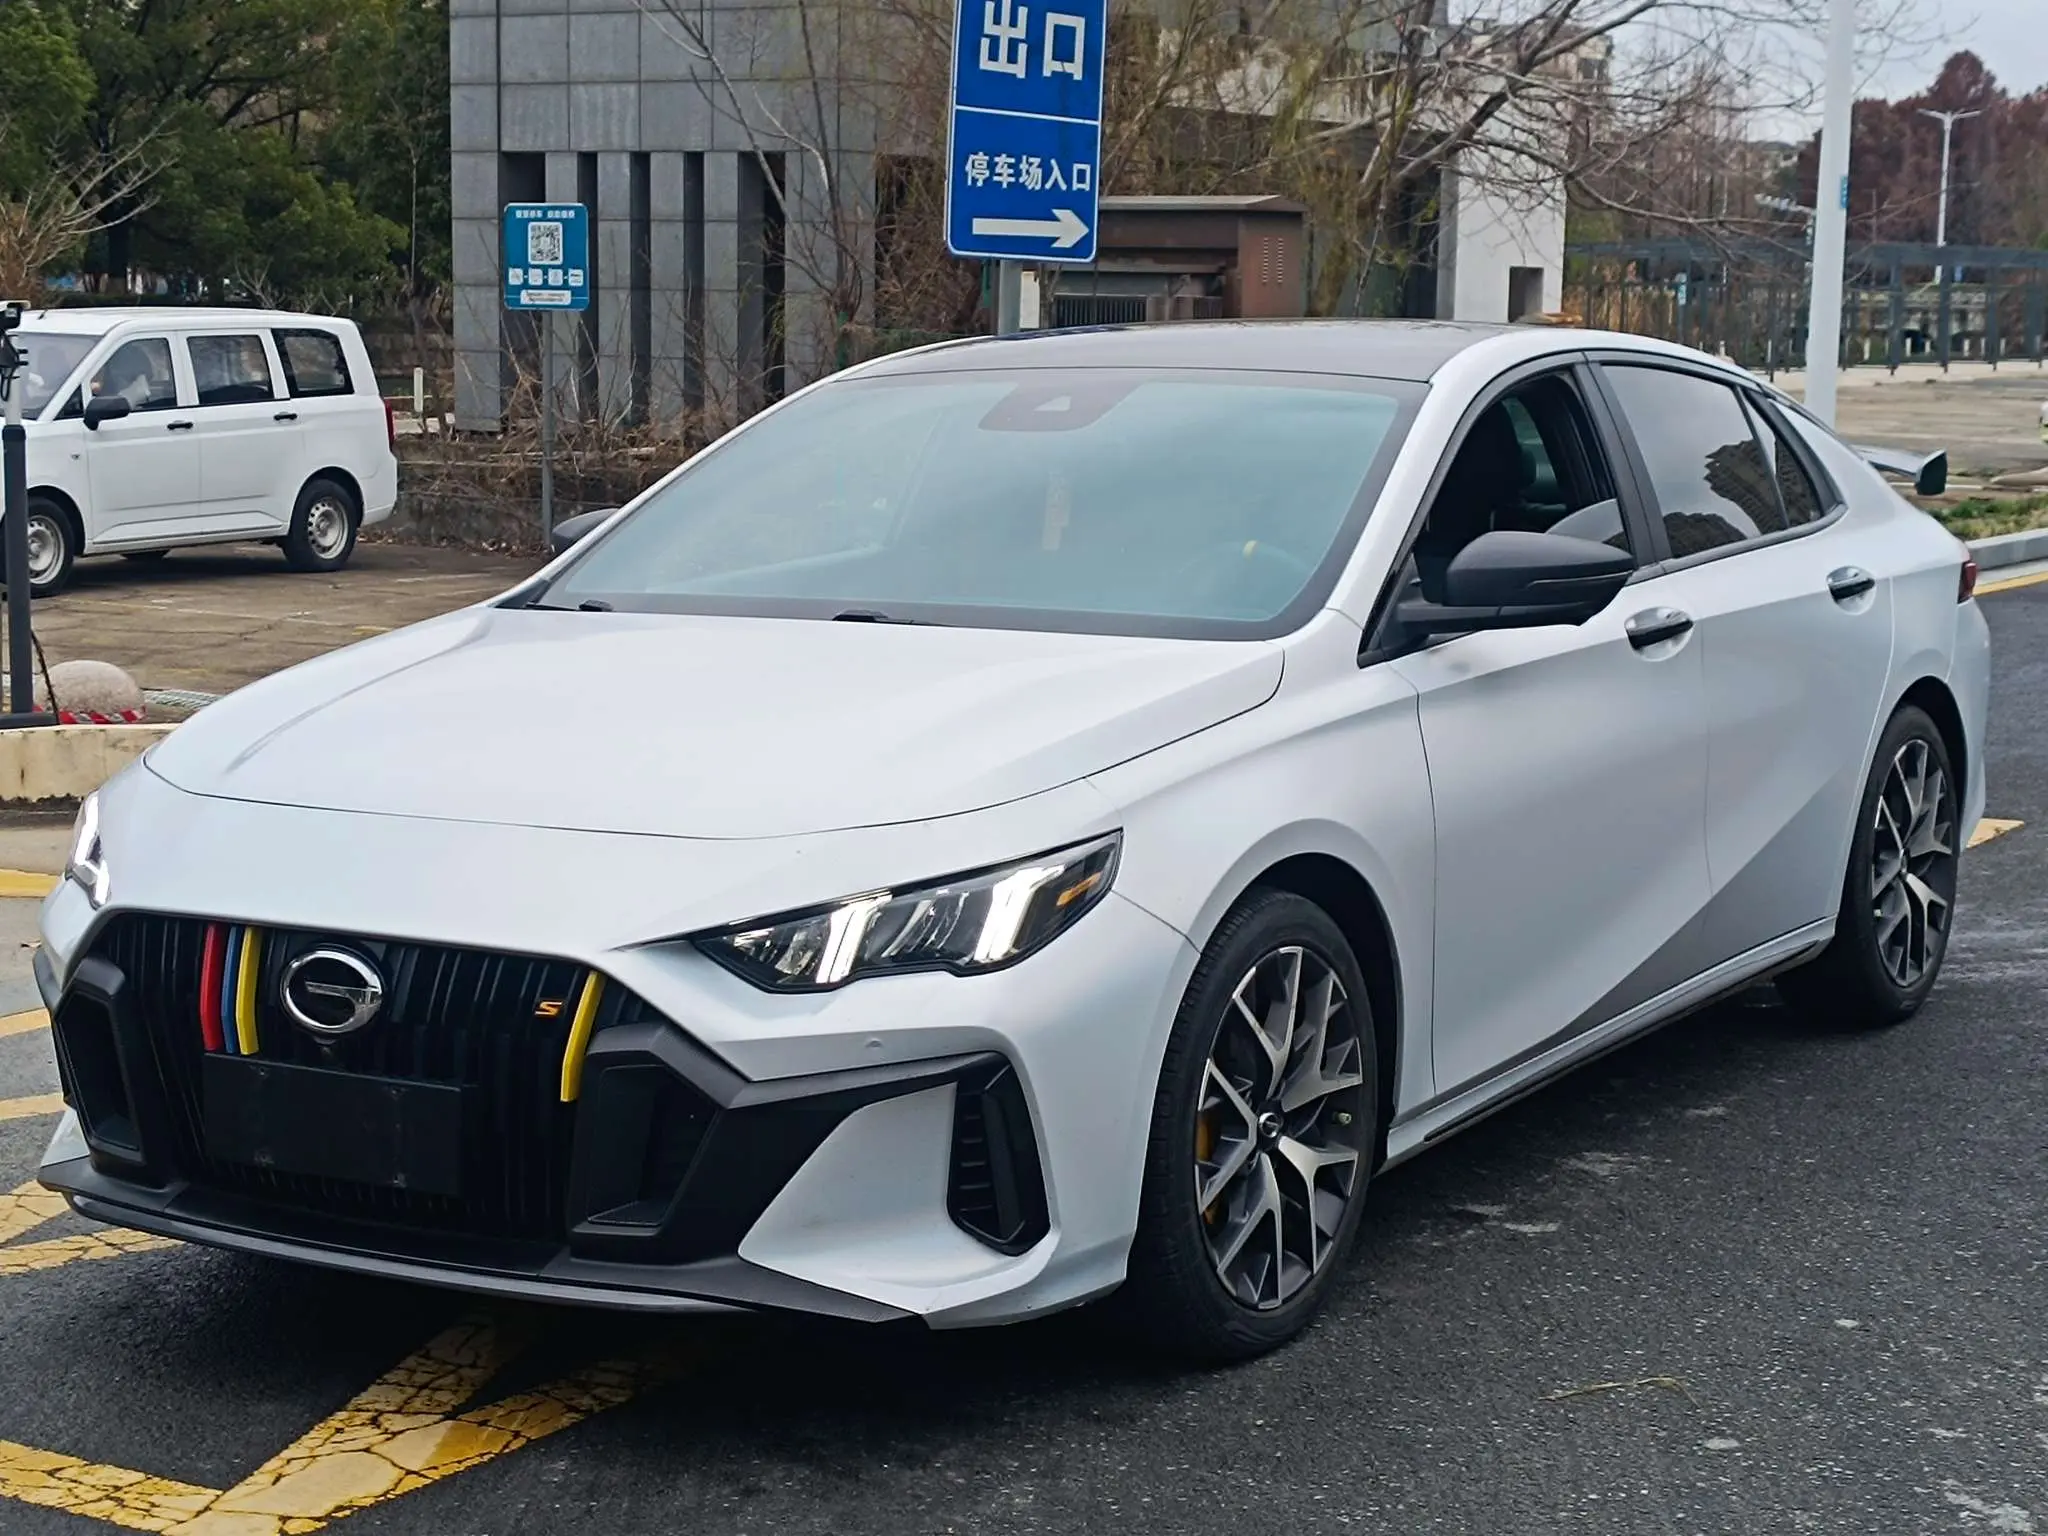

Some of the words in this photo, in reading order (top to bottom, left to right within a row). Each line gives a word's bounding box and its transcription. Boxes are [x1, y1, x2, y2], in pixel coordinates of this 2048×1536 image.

[979, 0, 1086, 80] 出口
[965, 152, 1092, 192] 停车场入口
[534, 1001, 563, 1016] S
